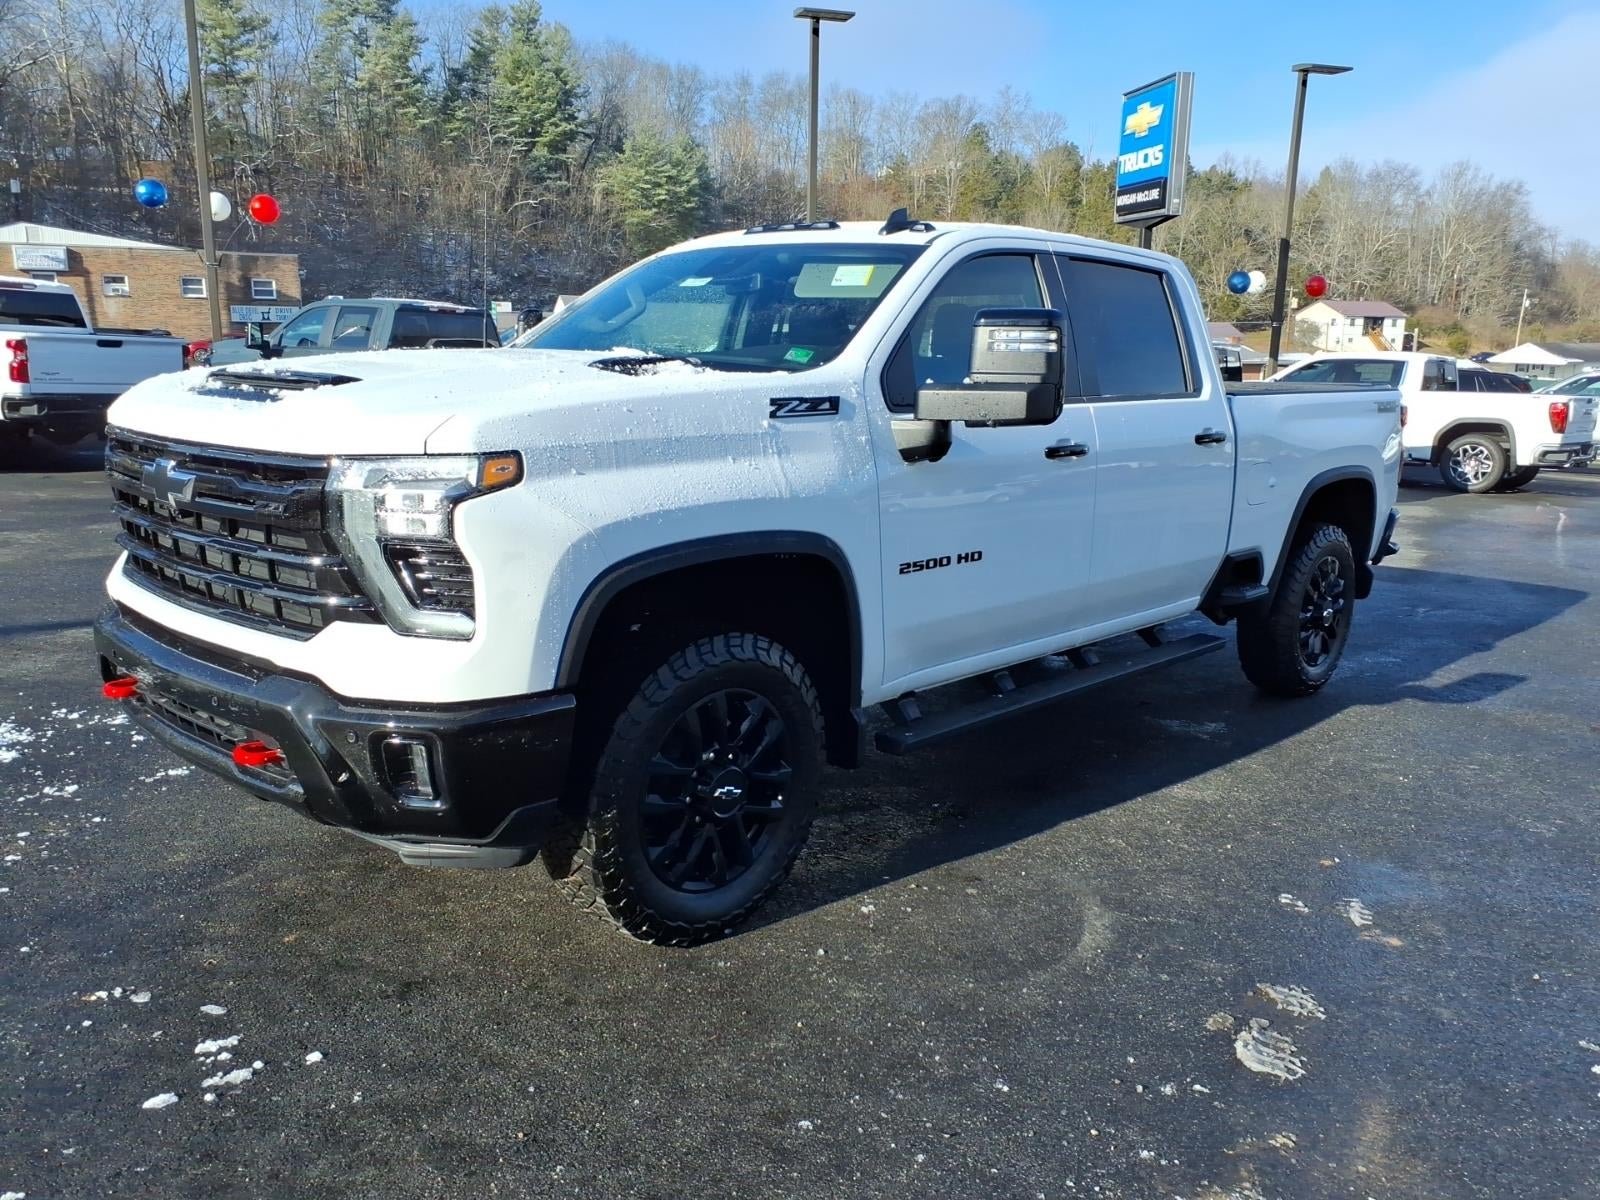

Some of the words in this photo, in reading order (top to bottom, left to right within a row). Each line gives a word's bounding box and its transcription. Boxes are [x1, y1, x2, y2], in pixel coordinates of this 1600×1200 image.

[1118, 144, 1164, 174] TRUCKS
[769, 396, 840, 418] Z71
[899, 555, 952, 575] 2500
[956, 550, 983, 565] HD
